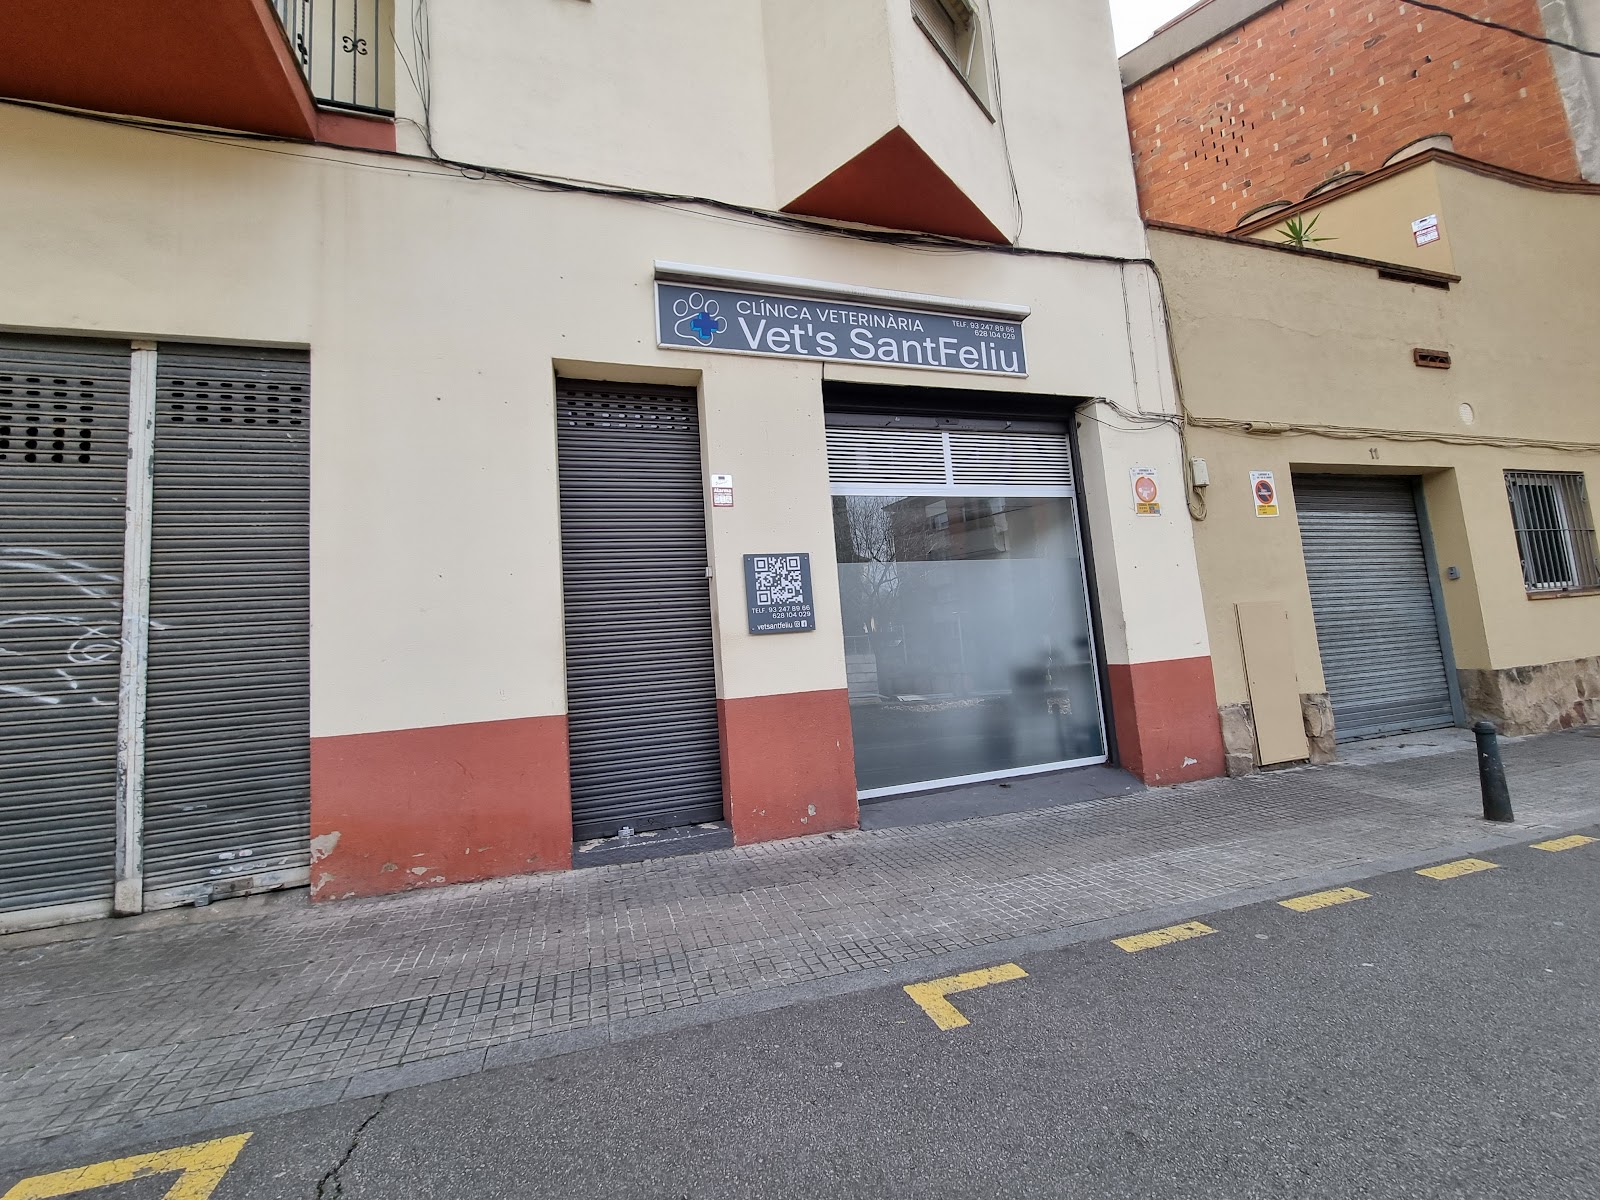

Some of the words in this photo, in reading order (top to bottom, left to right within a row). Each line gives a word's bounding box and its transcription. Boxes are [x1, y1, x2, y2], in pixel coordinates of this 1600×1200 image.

[736, 299, 812, 321] CLÍNICA
[816, 308, 925, 333] VETERINÀRIA
[952, 320, 969, 329] TELF.
[970, 322, 979, 330] 93
[981, 323, 993, 331] 247
[974, 329, 988, 338] 628
[1002, 332, 1016, 340] 029
[737, 317, 838, 356] Vet's
[849, 328, 1019, 373] SantFeliu
[1368, 447, 1380, 460] 11
[757, 622, 793, 630] vetsantfeliu
